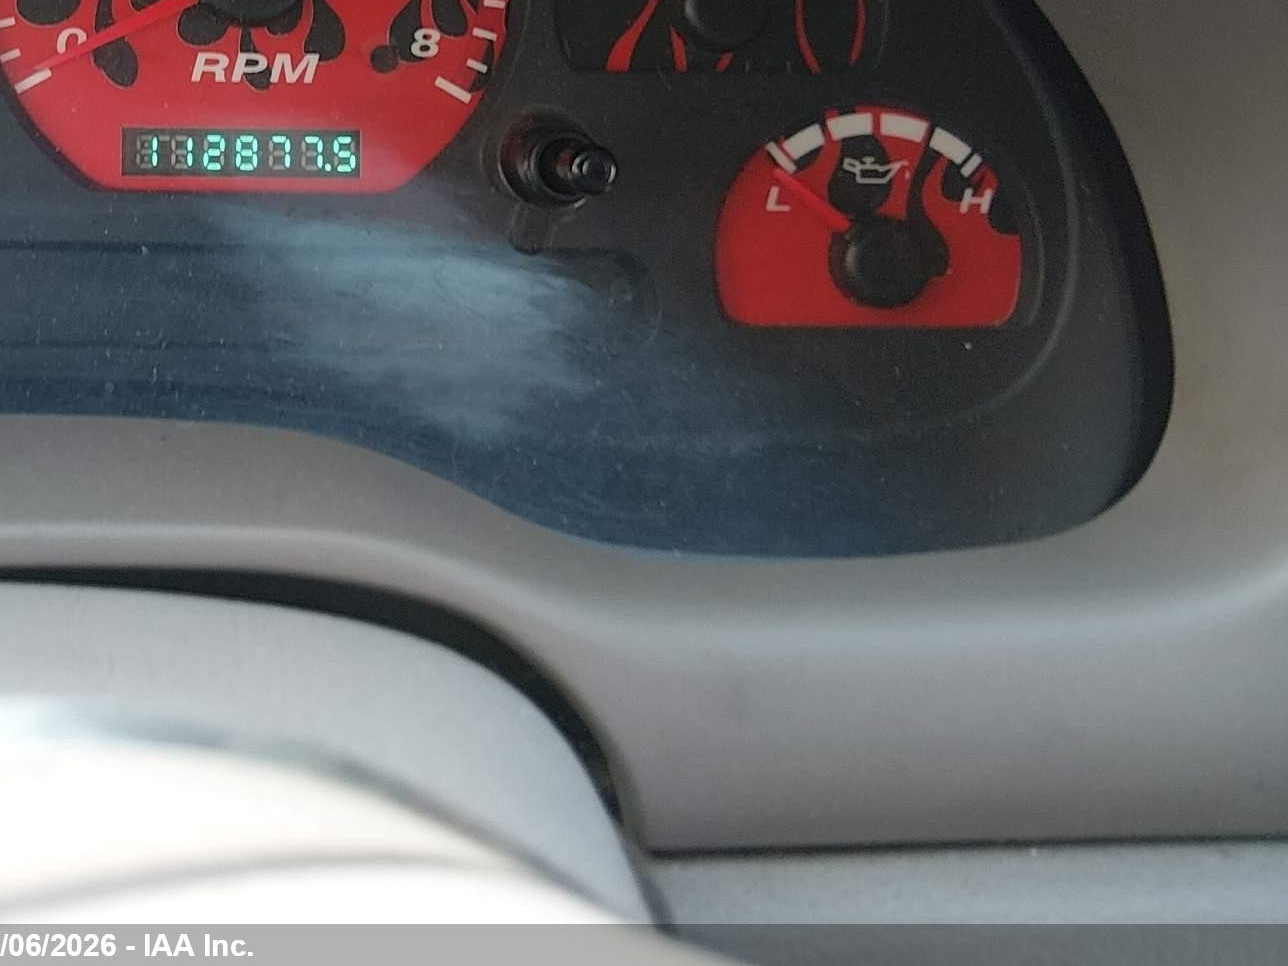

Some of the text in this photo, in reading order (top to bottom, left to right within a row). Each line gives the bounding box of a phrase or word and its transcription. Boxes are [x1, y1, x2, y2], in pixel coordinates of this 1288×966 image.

[410, 28, 442, 58] 8
[190, 52, 321, 84] RPM
[150, 133, 357, 172] 112877.5
[765, 185, 791, 212] L
[959, 187, 993, 214] H
